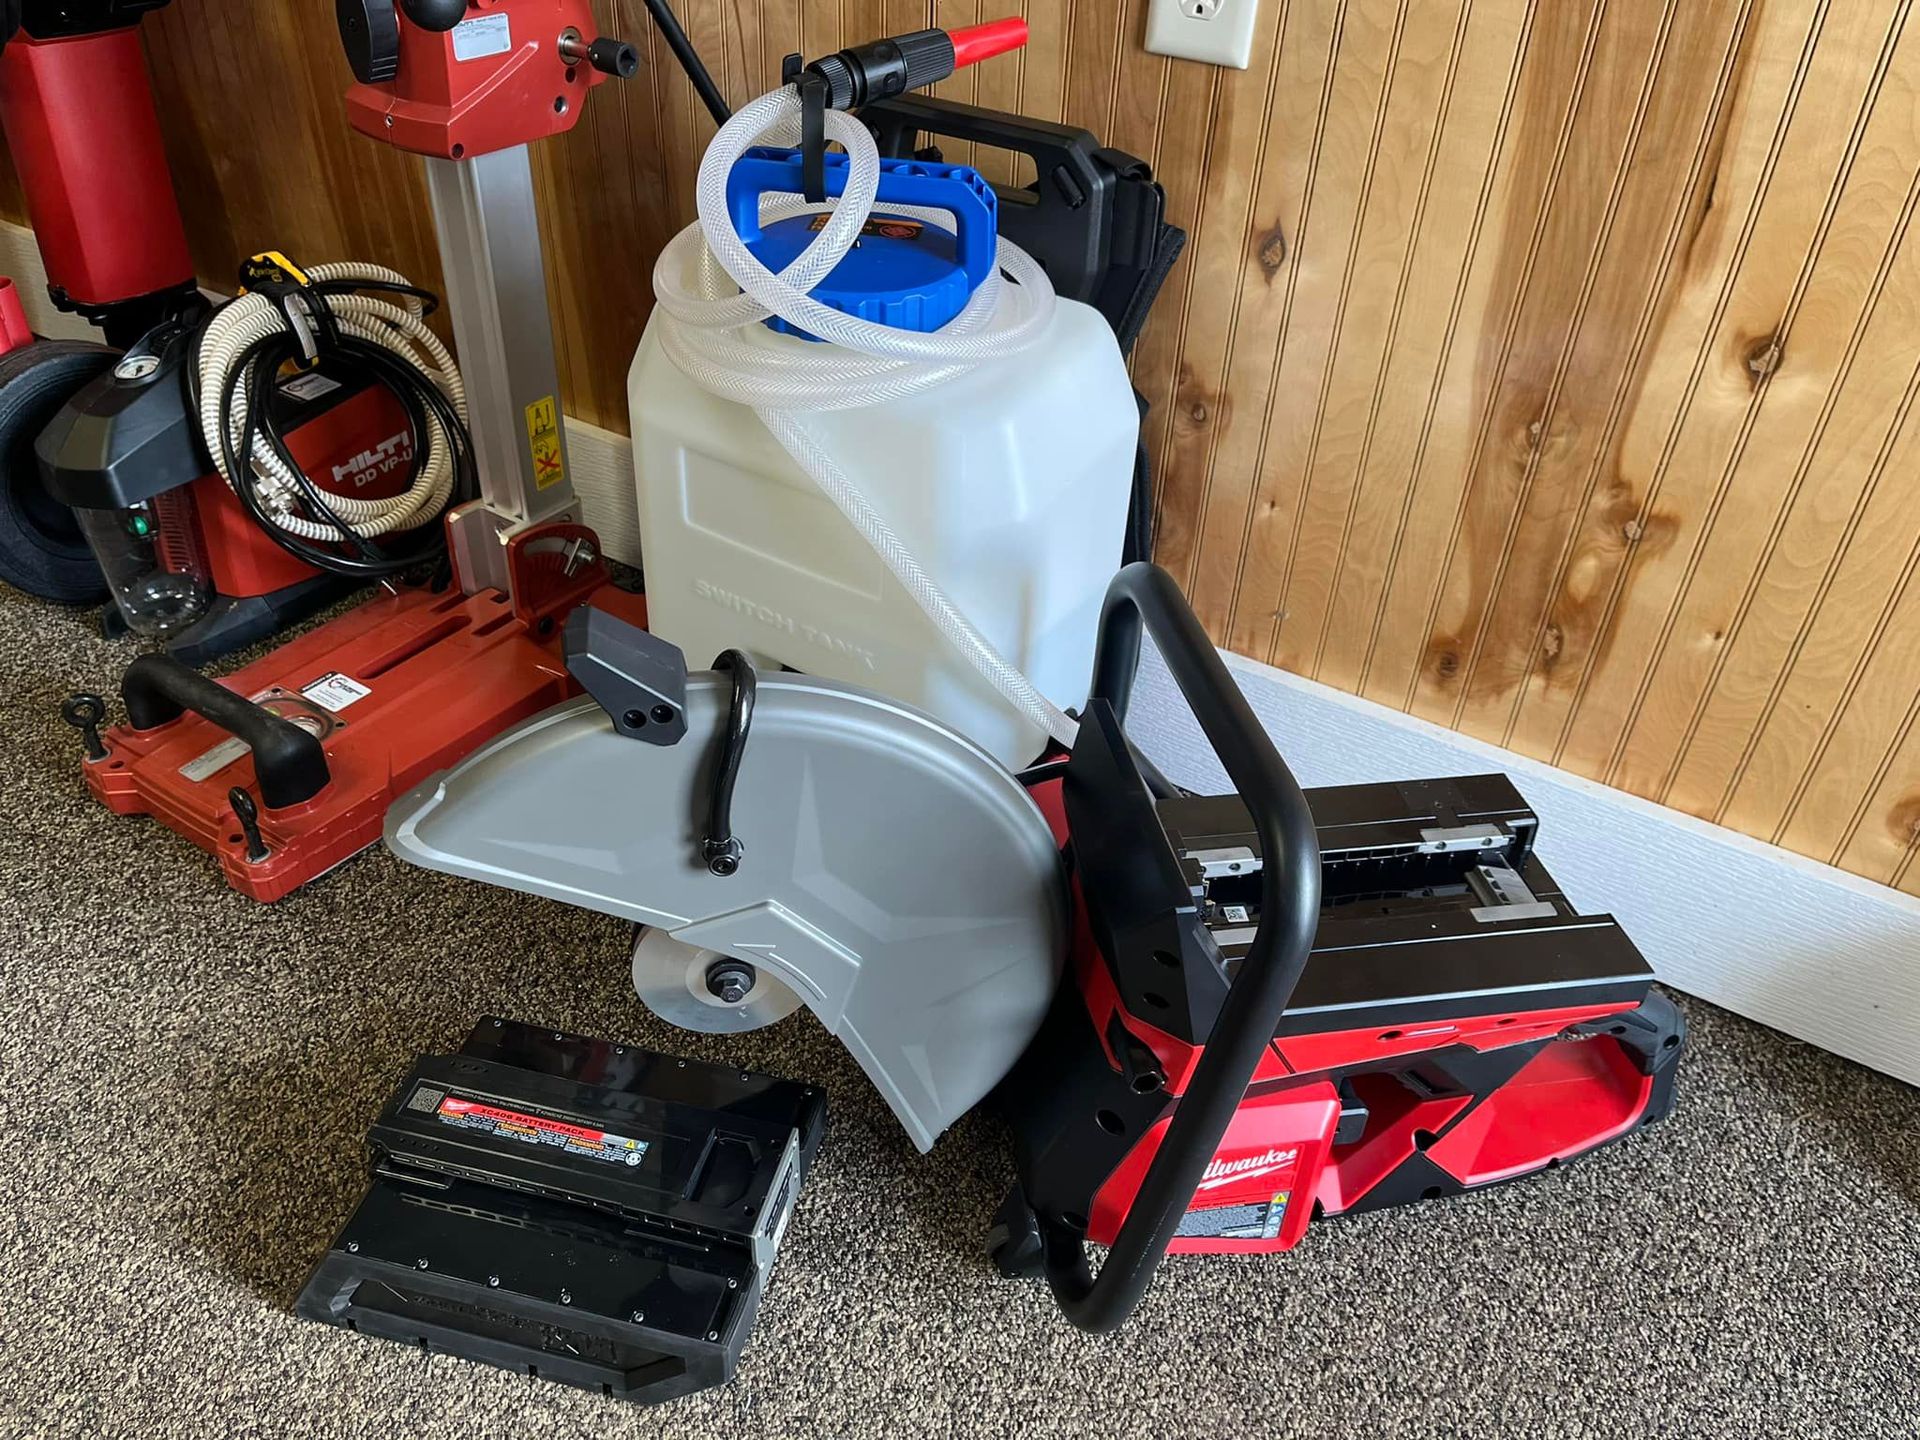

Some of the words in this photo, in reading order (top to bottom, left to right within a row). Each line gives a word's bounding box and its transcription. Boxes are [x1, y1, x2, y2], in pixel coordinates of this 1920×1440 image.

[332, 430, 410, 482] HILTI
[354, 467, 378, 488] DD
[379, 447, 413, 473] VP-U
[691, 578, 795, 634] SWITCH
[801, 624, 876, 671] TANK
[480, 1107, 513, 1120] XC406
[515, 1115, 558, 1129] BATTERY
[558, 1124, 586, 1136] PACK
[1202, 1148, 1298, 1180] ilwaukee
